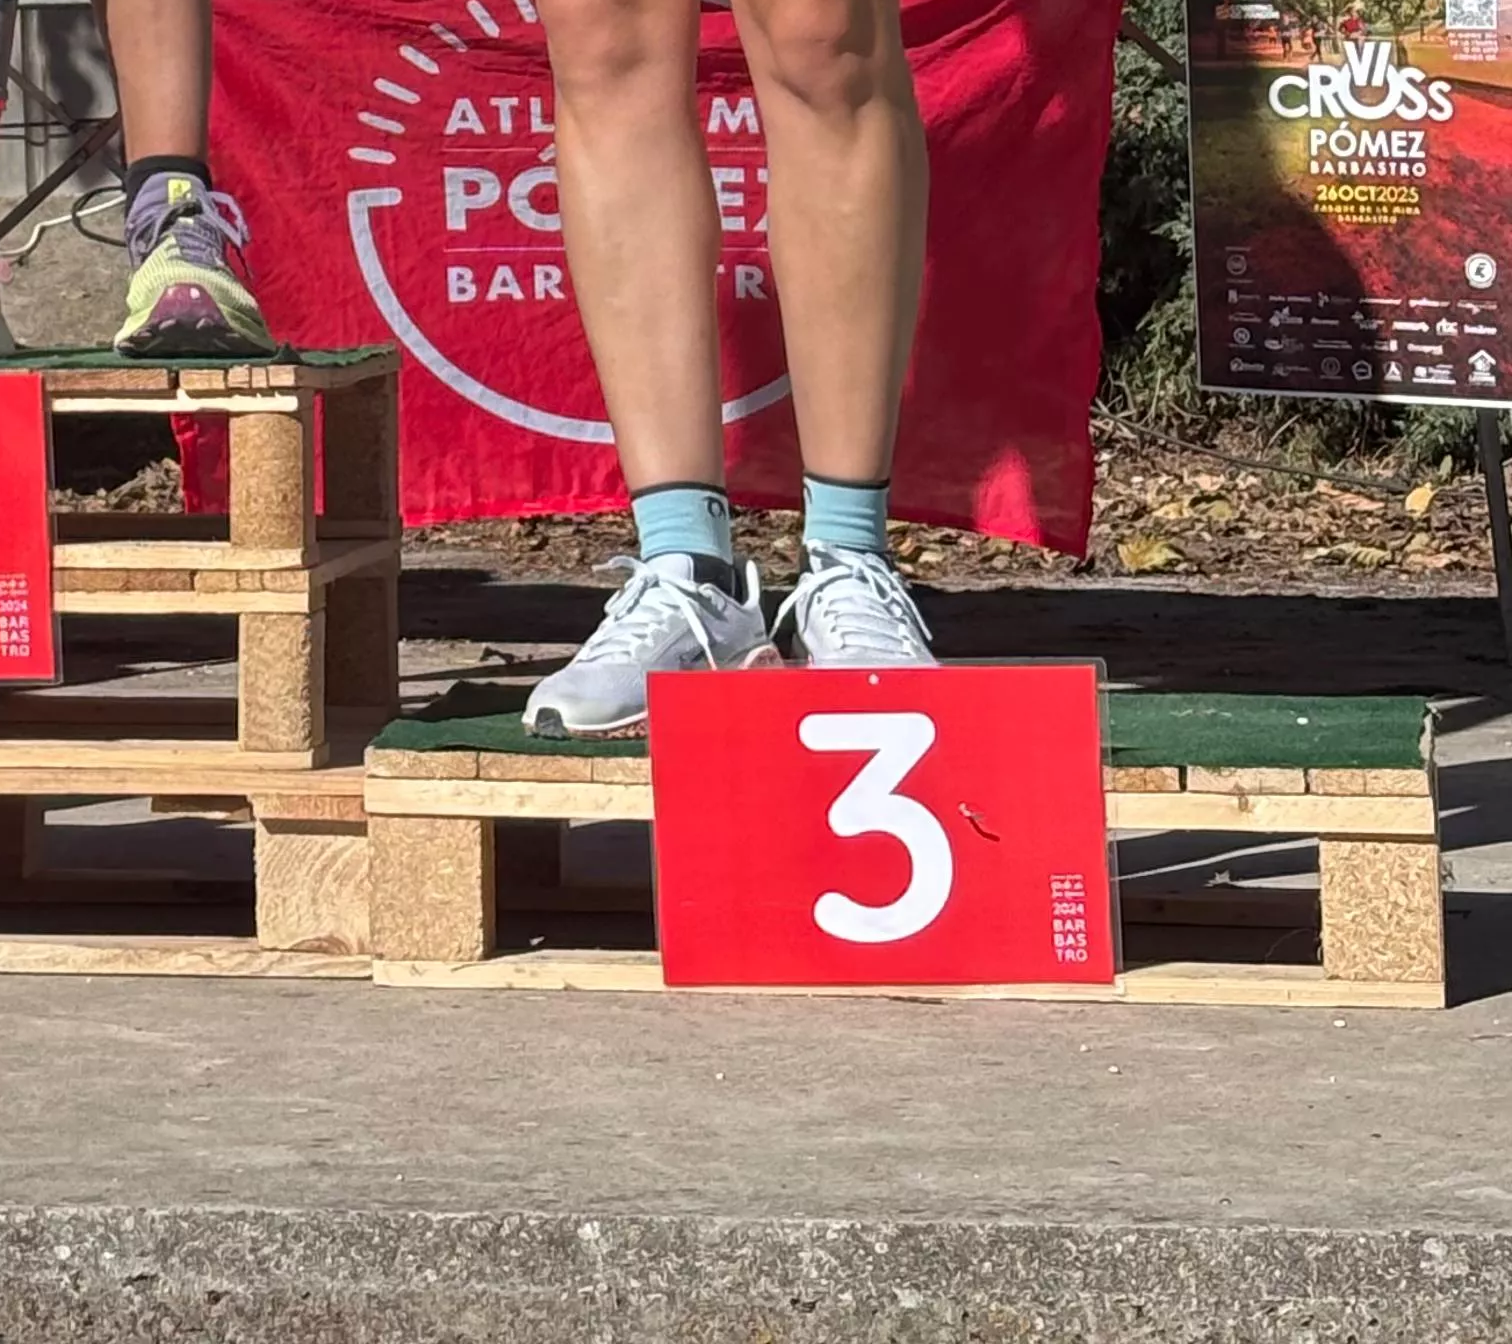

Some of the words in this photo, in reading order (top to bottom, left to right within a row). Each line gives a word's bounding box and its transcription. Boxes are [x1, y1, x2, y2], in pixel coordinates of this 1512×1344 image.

[1343, 41, 1392, 87] VI
[1268, 64, 1454, 122] CROSS
[1310, 121, 1426, 159] PÓMEZ
[1310, 160, 1427, 178] BARBASTRO
[1316, 184, 1420, 203] 26OCT2025
[798, 712, 953, 944] 3
[1052, 919, 1086, 932] BAR
[1054, 933, 1087, 947] BAS
[1055, 948, 1088, 962] TRO
